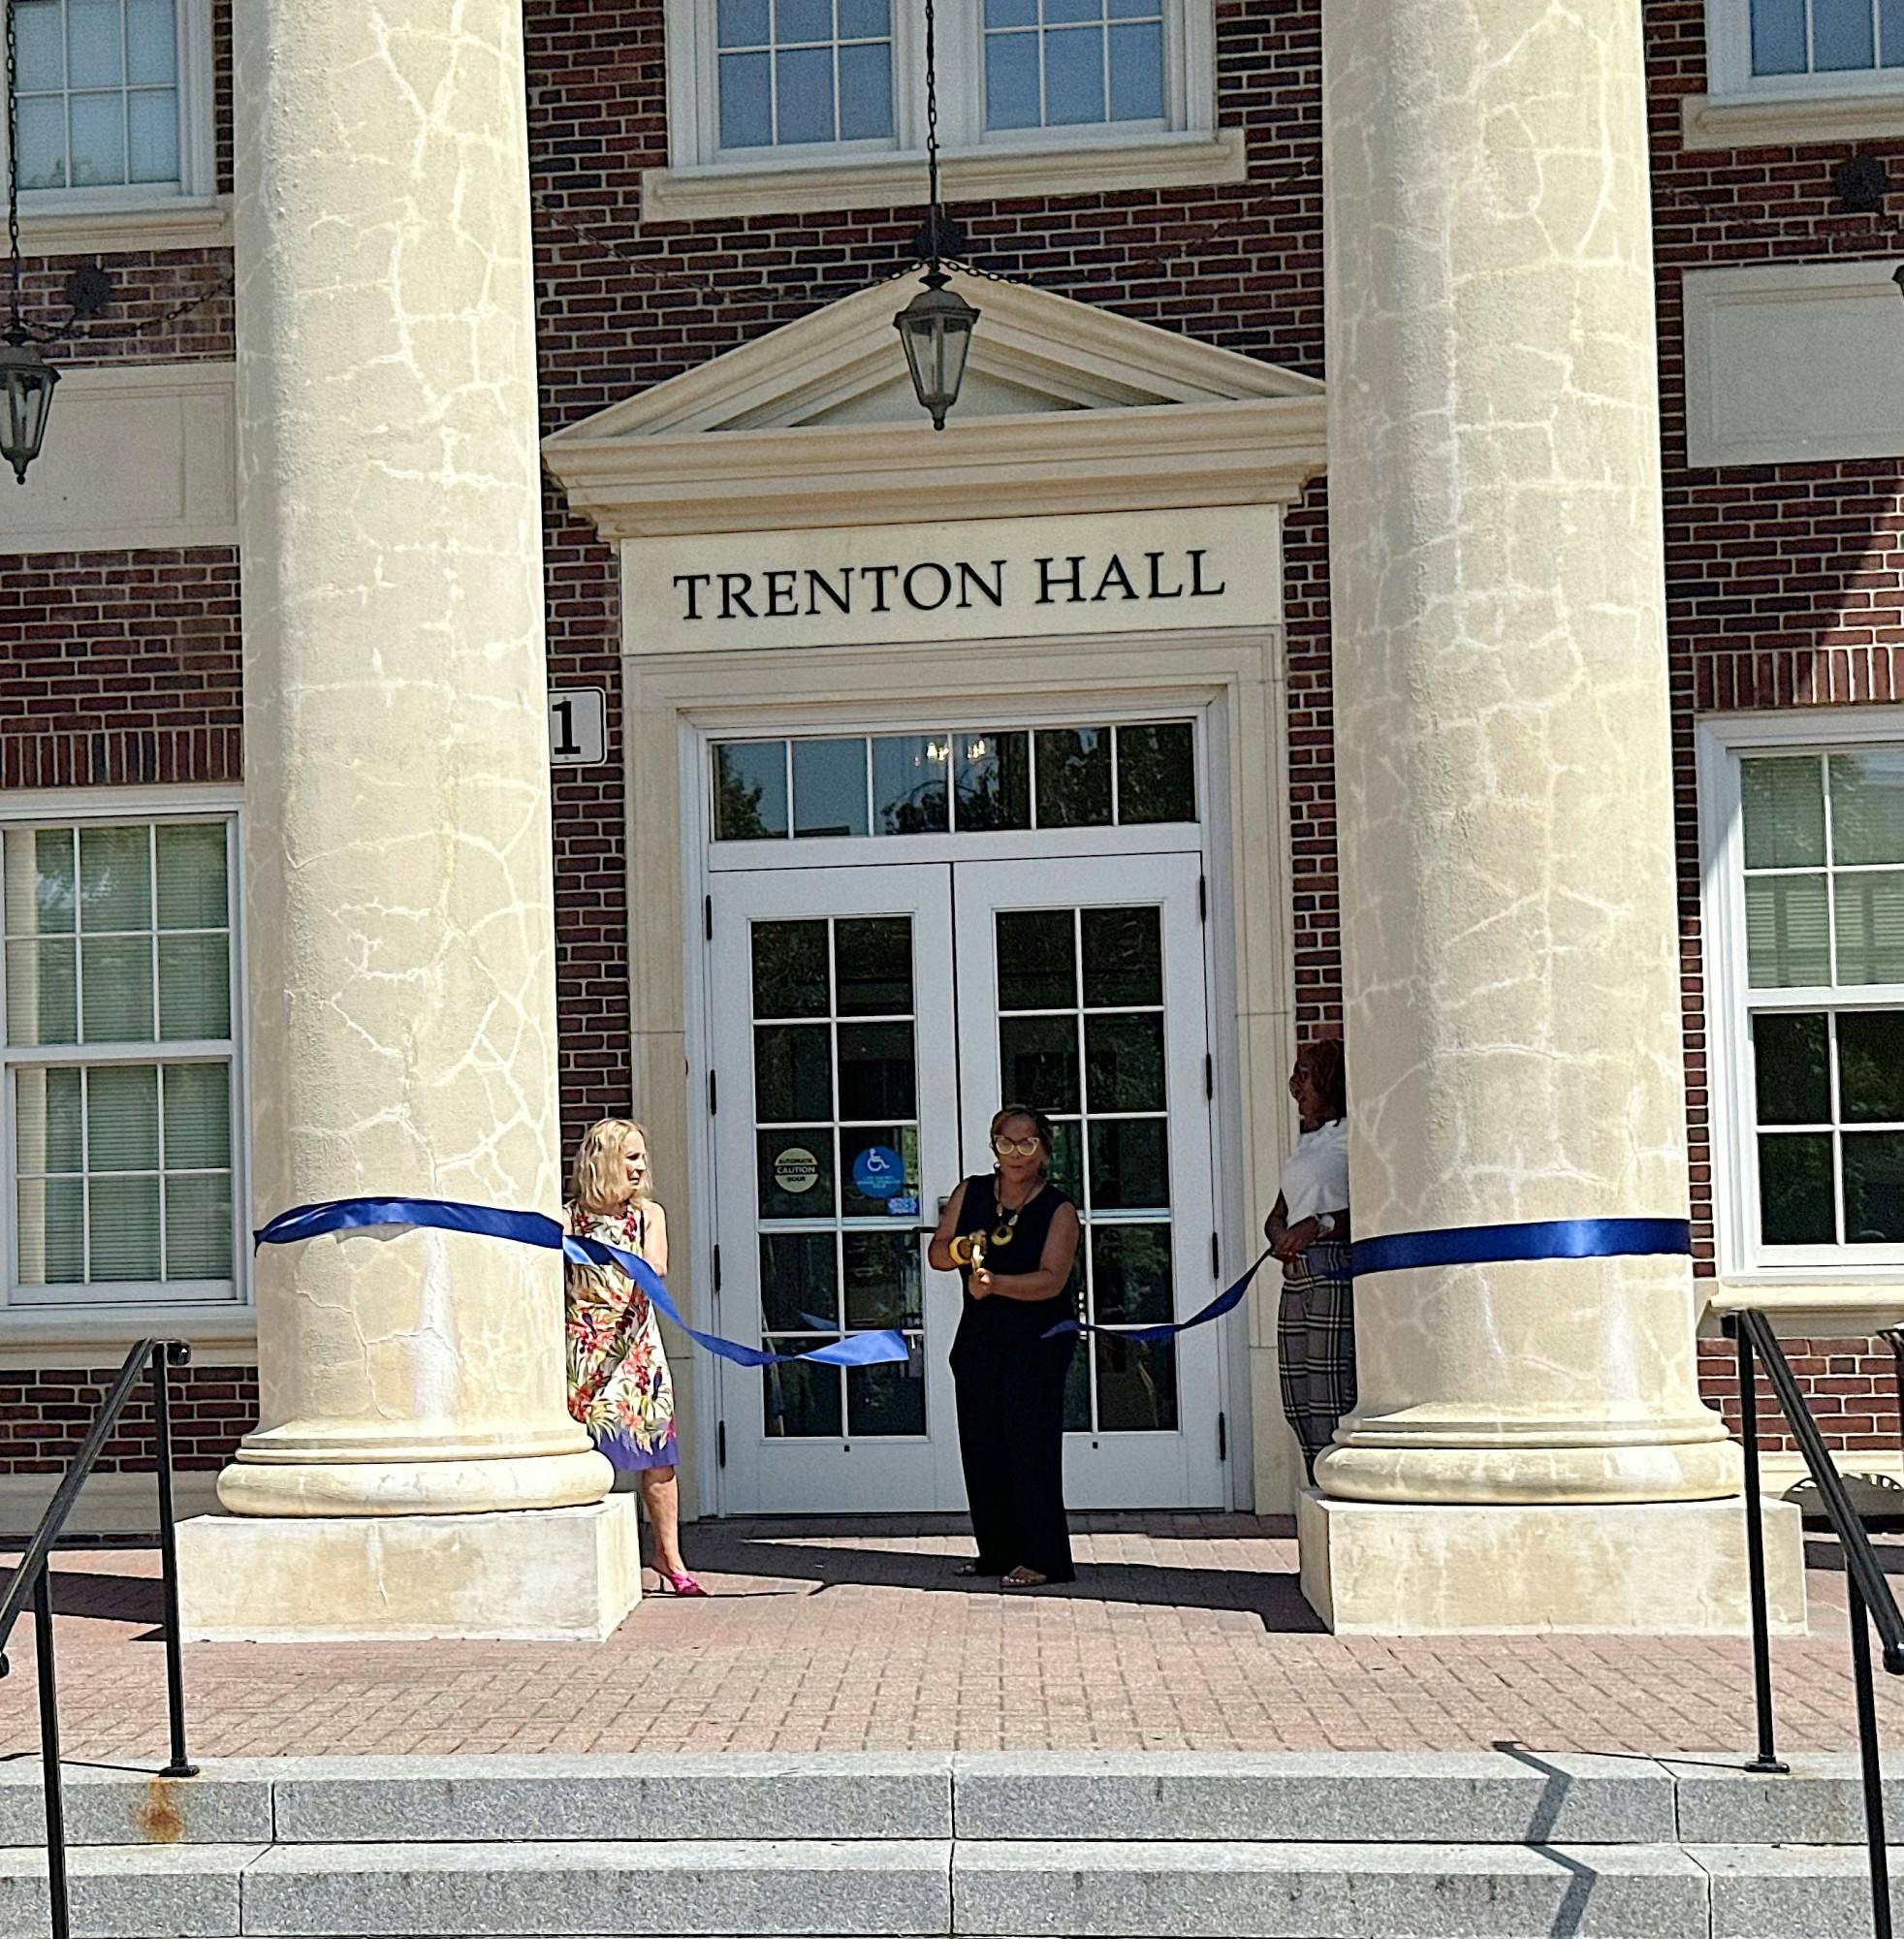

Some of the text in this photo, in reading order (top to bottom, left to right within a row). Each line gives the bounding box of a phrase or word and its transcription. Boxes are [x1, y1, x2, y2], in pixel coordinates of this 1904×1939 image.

[673, 550, 1225, 620] TRENTON HALL
[552, 700, 582, 755] 1
[777, 1165, 816, 1175] CAUTION
